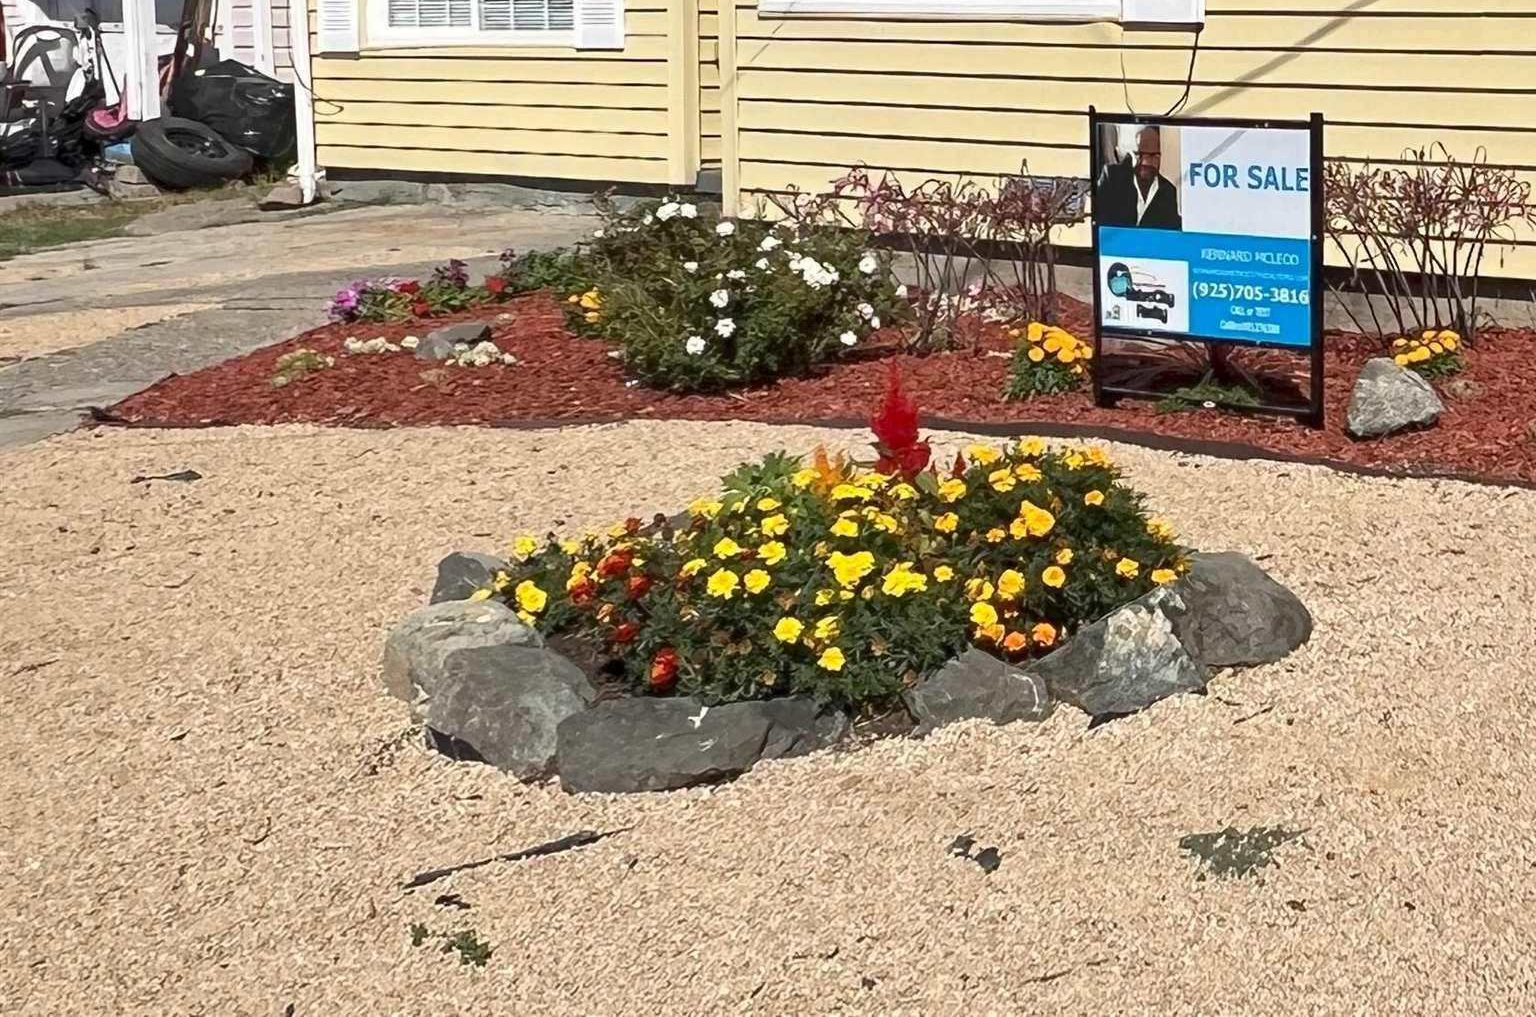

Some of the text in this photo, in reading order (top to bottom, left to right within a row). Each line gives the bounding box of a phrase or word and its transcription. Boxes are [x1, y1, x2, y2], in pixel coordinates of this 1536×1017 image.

[1189, 162, 1309, 192] FOR SALE
[1192, 281, 1310, 305] (925)705-3816
